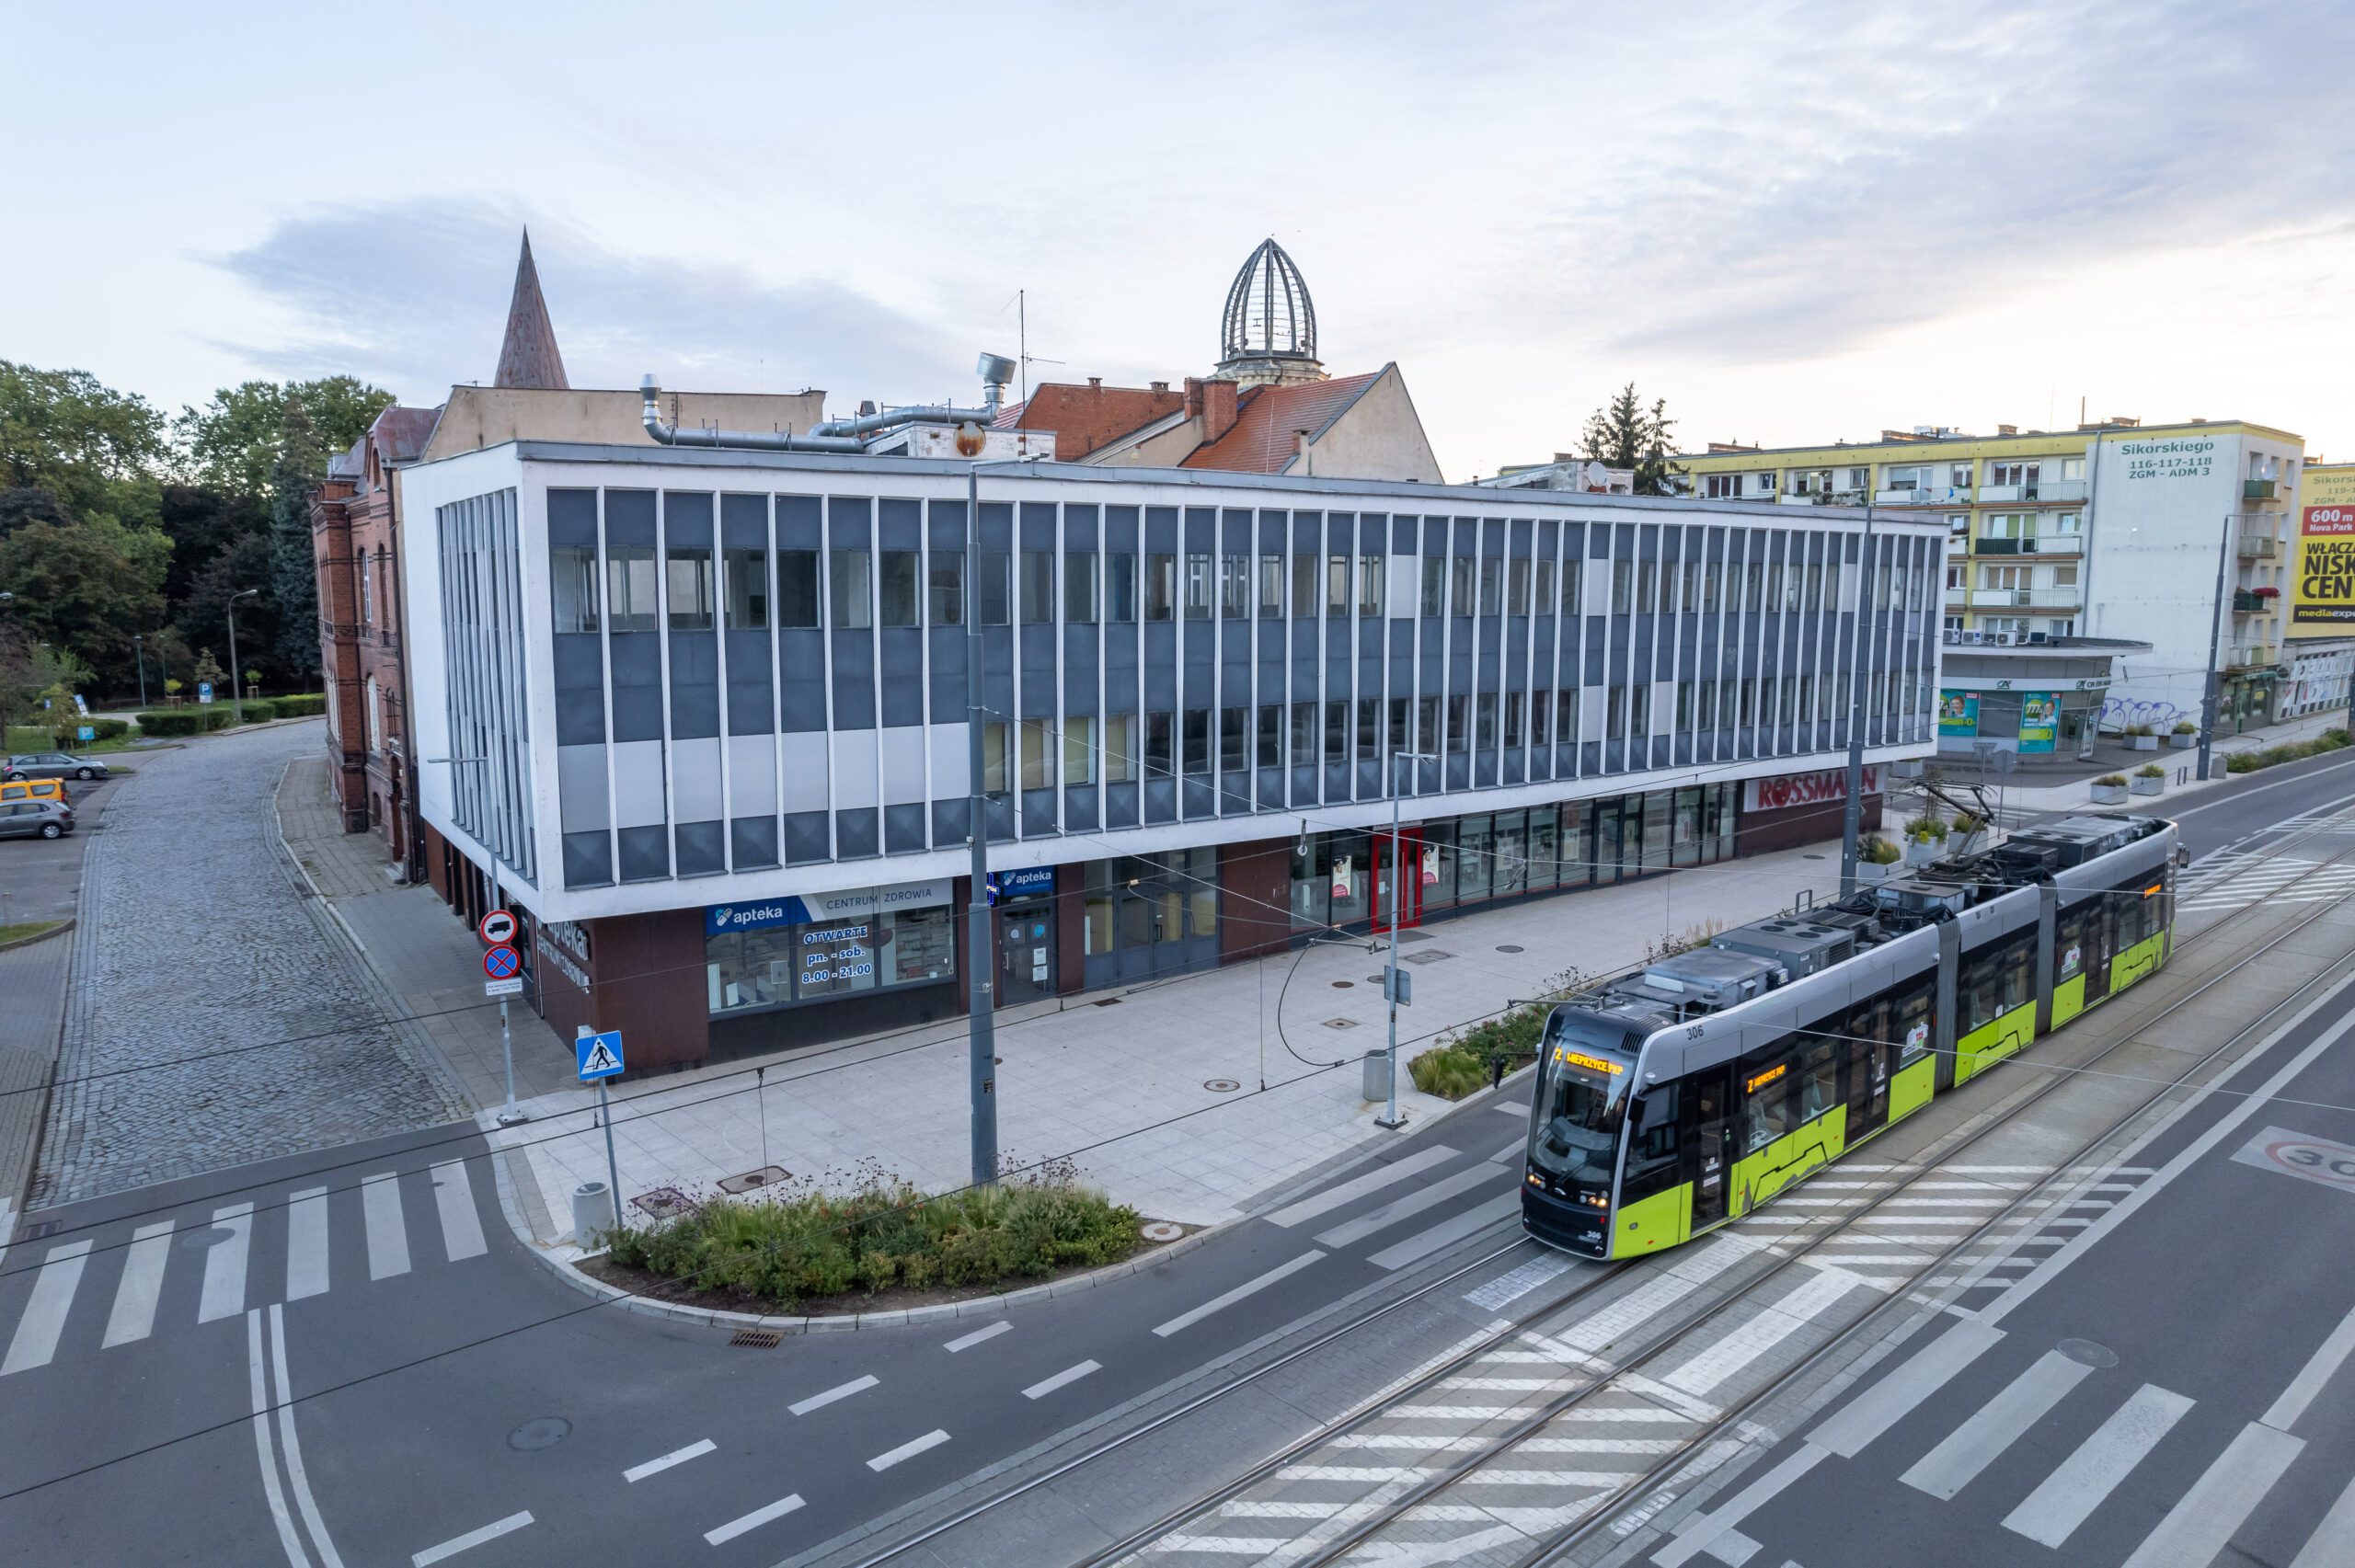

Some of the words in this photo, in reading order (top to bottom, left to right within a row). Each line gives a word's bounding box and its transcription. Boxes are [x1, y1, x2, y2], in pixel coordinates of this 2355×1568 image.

[2121, 441, 2214, 455] Sikorskiego
[2130, 457, 2212, 469] 116-117-118
[2129, 470, 2155, 479] ZGM
[2169, 467, 2198, 477] ADM
[2202, 467, 2210, 475] 3
[2314, 475, 2355, 485] Sikors
[2311, 509, 2341, 522] 600
[2310, 523, 2331, 532] Nova
[2302, 576, 2355, 599] CEN
[1758, 765, 1877, 808] ROSSMAN
[1016, 871, 1051, 885] apteka
[827, 895, 879, 910] CENTRUM
[884, 888, 932, 902] ZDROWIA
[733, 906, 783, 924] apteka
[804, 926, 867, 945] OTWARTE
[807, 953, 828, 967] pn.
[840, 946, 866, 958] sob.
[802, 970, 829, 983] 8.00
[839, 964, 872, 979] 21.00
[1686, 1024, 1704, 1040] 306
[1555, 1048, 1562, 1060] 2
[1748, 1079, 1753, 1093] 2
[1587, 1230, 1602, 1240] 306
